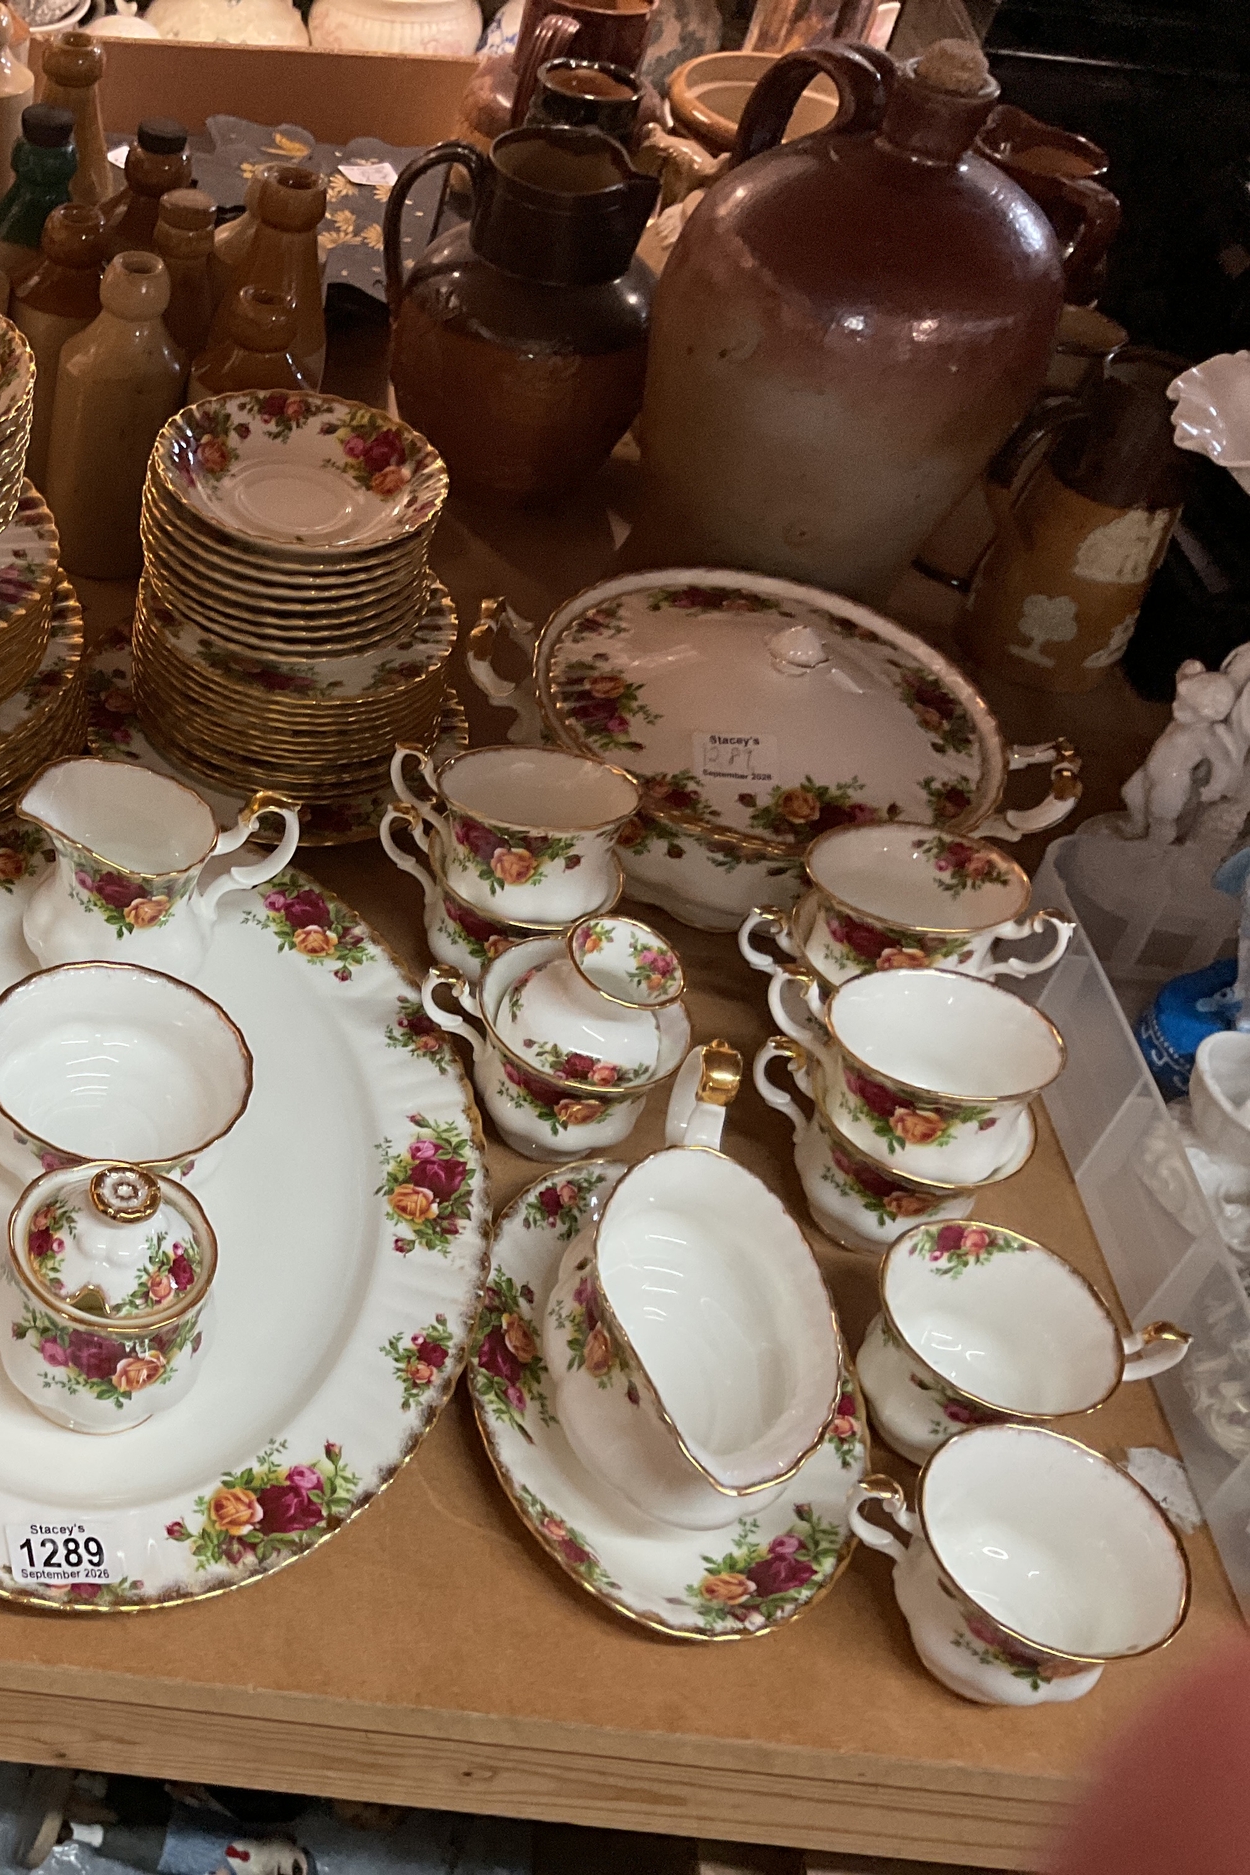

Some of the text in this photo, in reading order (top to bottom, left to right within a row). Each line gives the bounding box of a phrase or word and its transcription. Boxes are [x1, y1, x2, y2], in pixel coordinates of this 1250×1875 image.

[709, 735, 760, 747] Stacey's
[703, 768, 748, 780] September
[30, 1523, 85, 1536] Stacey's
[19, 1536, 105, 1568] 1289
[21, 1567, 110, 1580] September 2026
